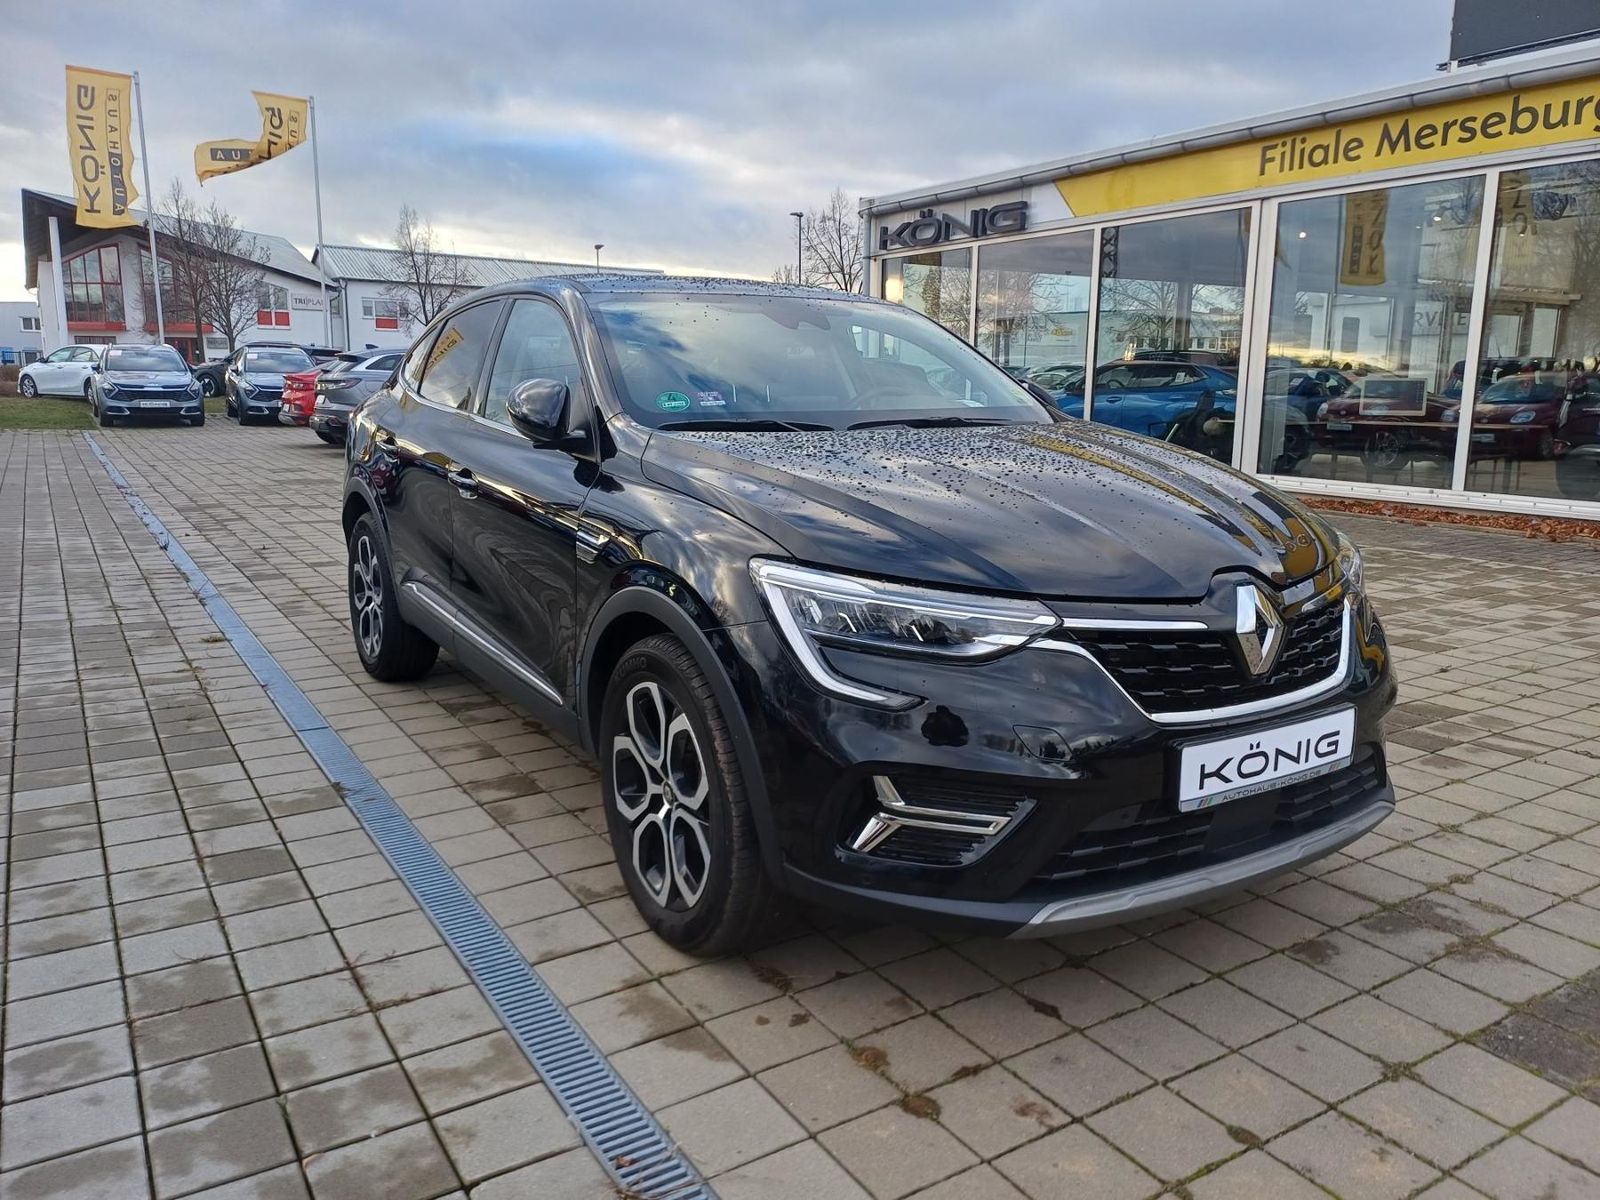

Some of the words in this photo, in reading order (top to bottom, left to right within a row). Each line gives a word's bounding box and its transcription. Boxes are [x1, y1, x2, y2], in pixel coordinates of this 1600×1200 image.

[1259, 129, 1364, 176] Filiale
[1375, 95, 1600, 157] Mersebur
[879, 201, 1028, 250] KÖNIG
[1199, 730, 1340, 790] KÖNIG
